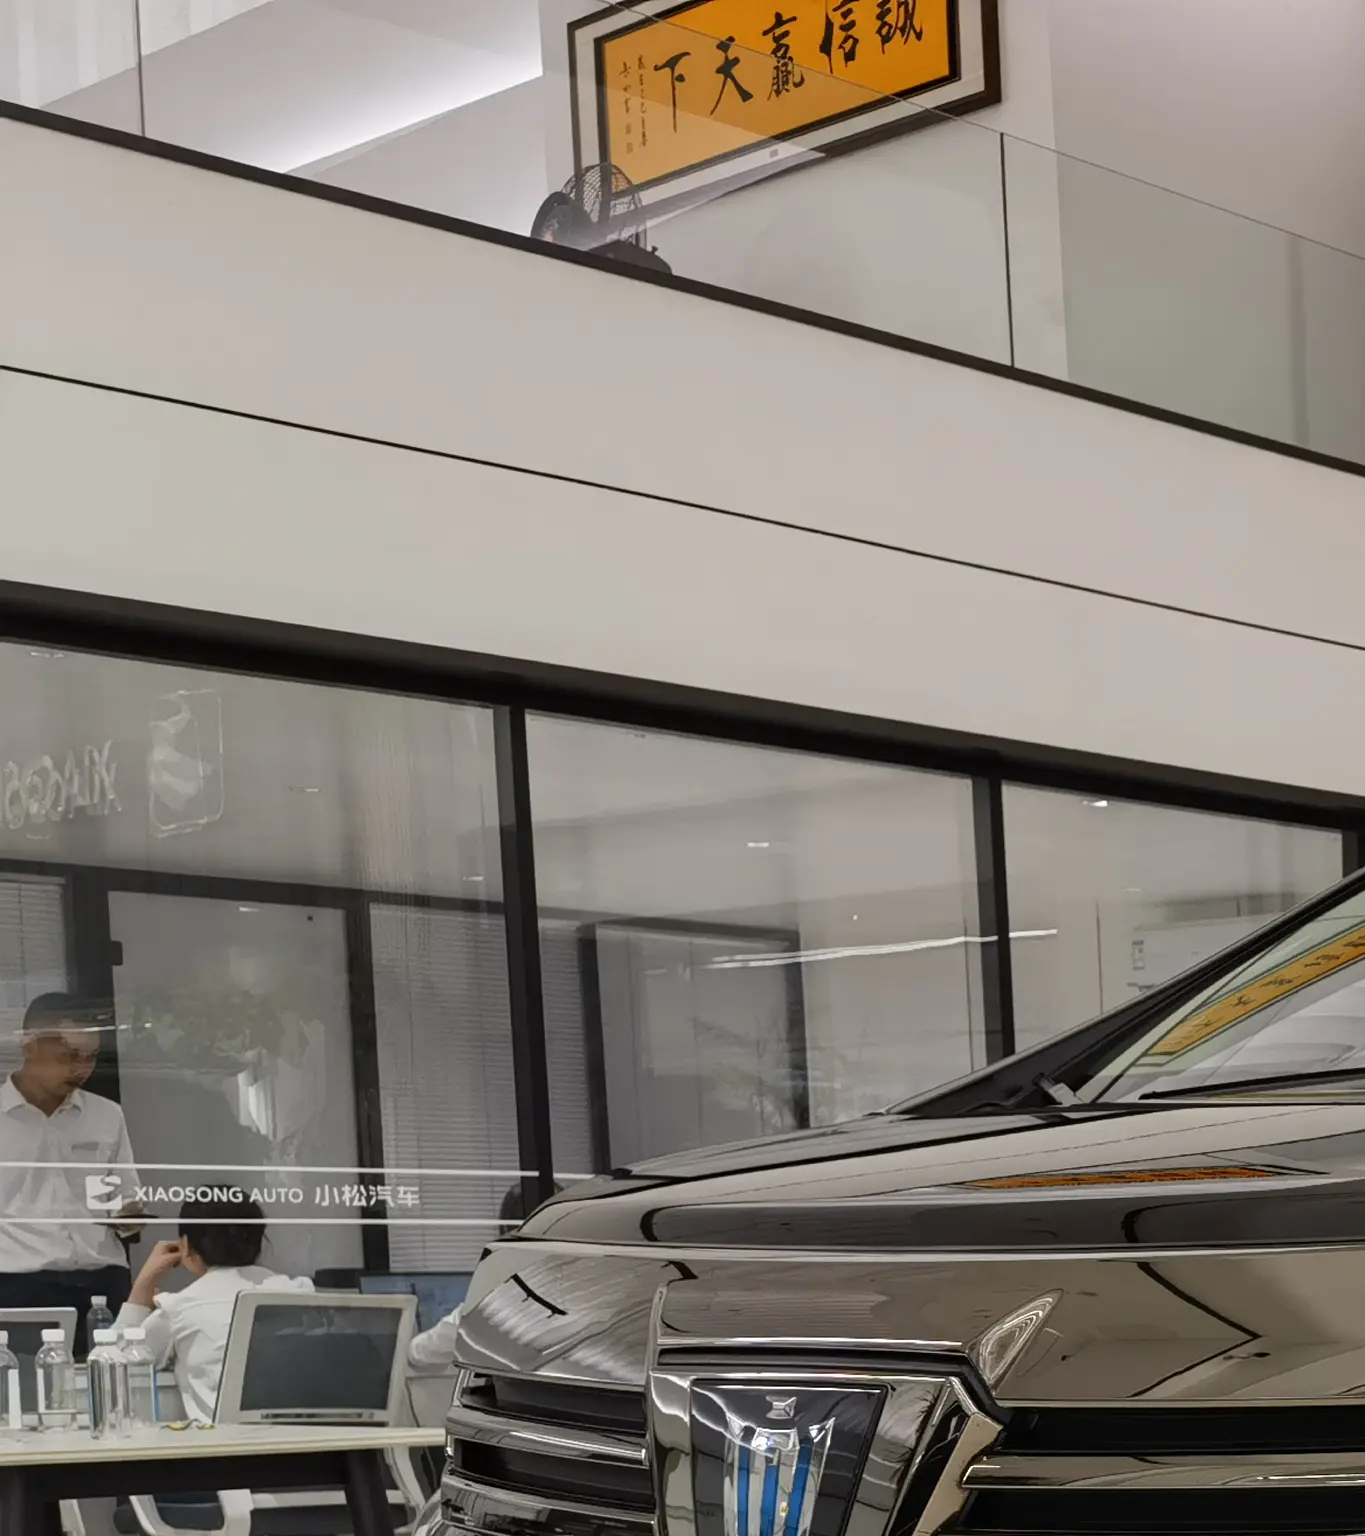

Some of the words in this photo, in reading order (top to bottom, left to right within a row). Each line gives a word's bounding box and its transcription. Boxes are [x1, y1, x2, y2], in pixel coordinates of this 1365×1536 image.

[134, 1185, 243, 1203] XIAOSONG
[249, 1187, 304, 1204] AUTO
[314, 1184, 420, 1207] 小松汽车
